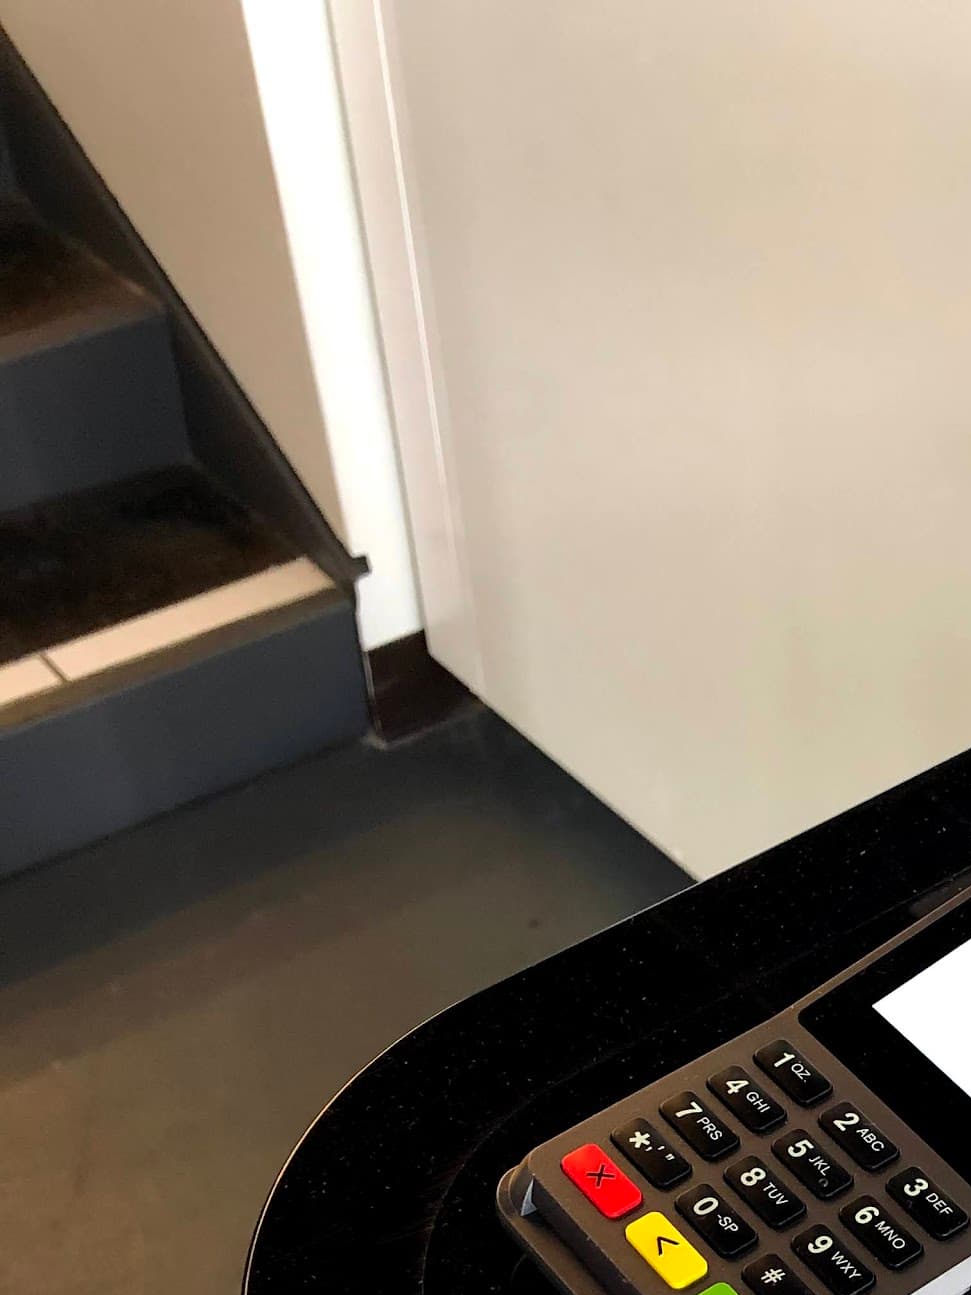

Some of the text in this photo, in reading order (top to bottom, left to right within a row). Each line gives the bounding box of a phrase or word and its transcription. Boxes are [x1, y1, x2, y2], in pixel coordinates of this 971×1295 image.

[774, 1052, 795, 1068] 1
[726, 1080, 770, 1113] 4 GHI
[675, 1101, 723, 1141] 7 PRS
[833, 1112, 885, 1152] 2 ABC
[788, 1139, 831, 1177] 5 JKL
[740, 1167, 789, 1206] 8 TUV
[904, 1178, 953, 1216] 3 DEF
[693, 1196, 719, 1216] 0
[854, 1206, 906, 1250] 6 MNO
[807, 1236, 862, 1280] 9 WXY
